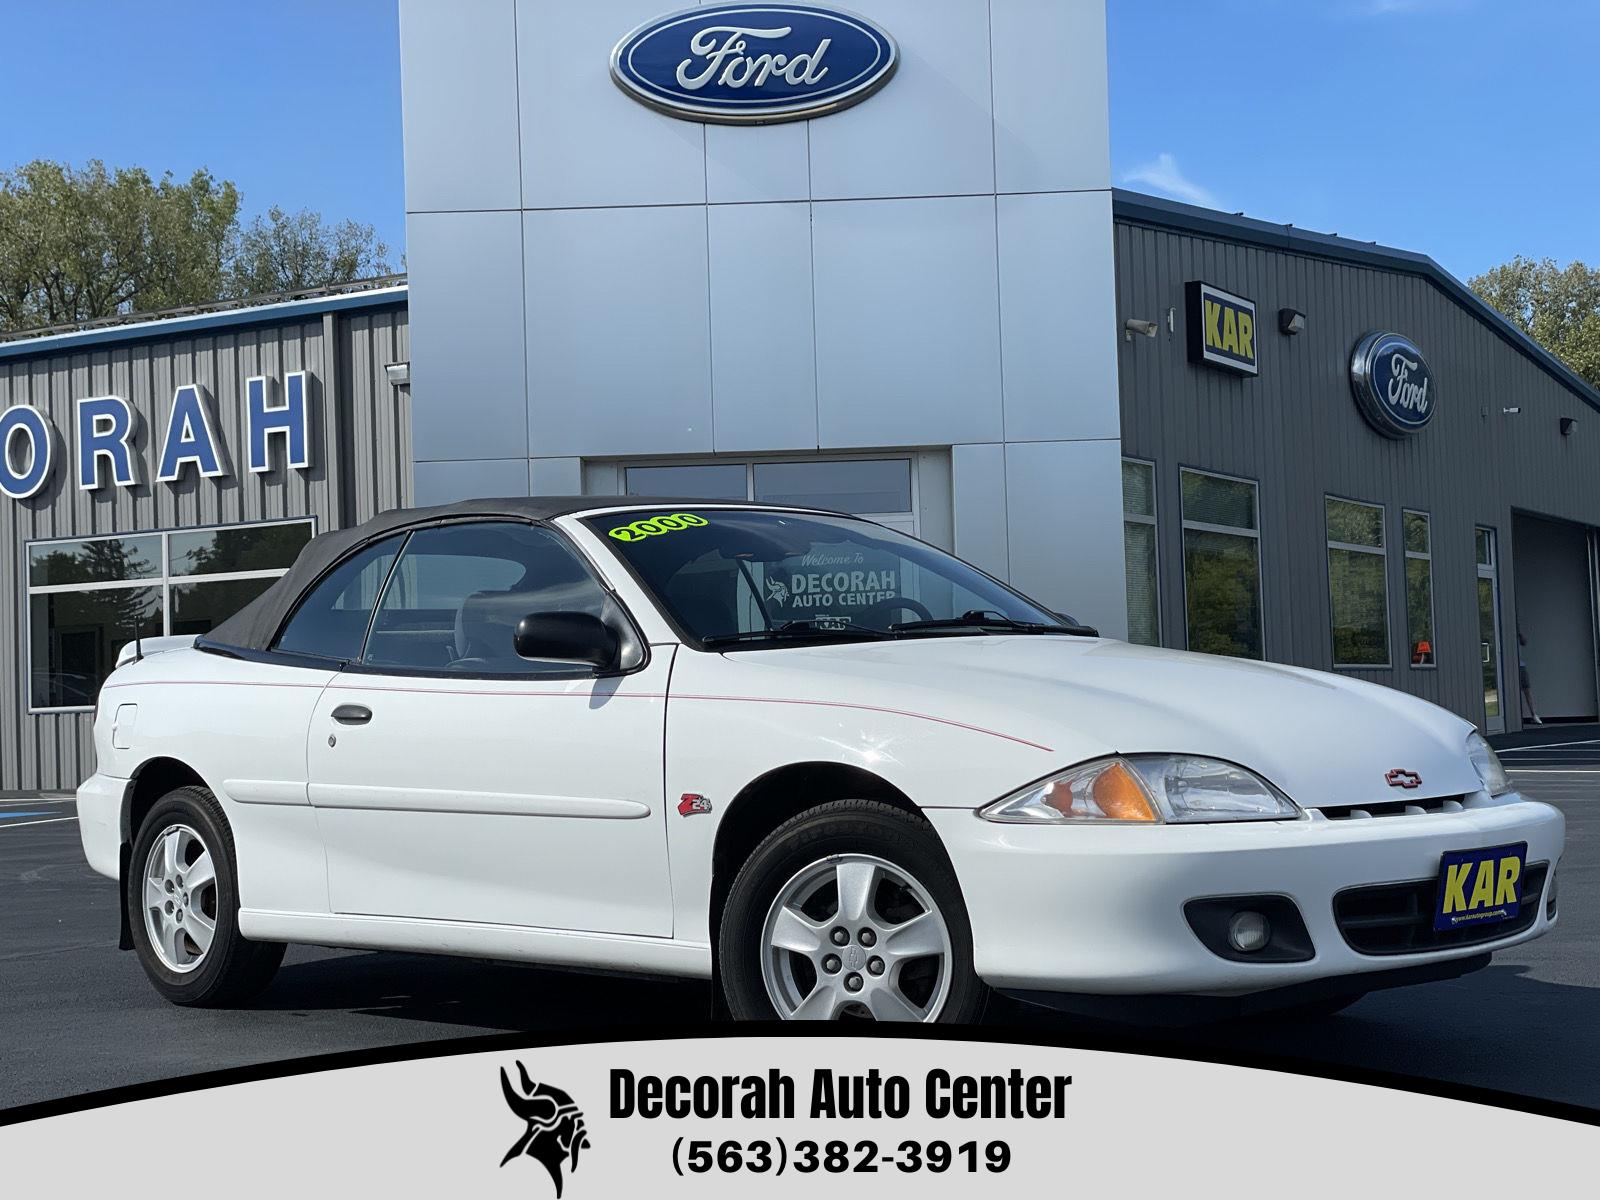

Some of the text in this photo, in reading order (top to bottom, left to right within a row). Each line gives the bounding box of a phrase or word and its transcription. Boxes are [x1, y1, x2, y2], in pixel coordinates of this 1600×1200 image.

[676, 26, 831, 90] Ford
[1204, 299, 1254, 359] KAR
[1388, 353, 1428, 414] Ford
[0, 370, 312, 499] ORAH
[608, 513, 709, 542] 2000
[791, 570, 896, 594] DECORAH
[801, 552, 864, 567] Welcome To
[792, 590, 896, 608] AUTO CENTER
[1443, 856, 1520, 914] KAR
